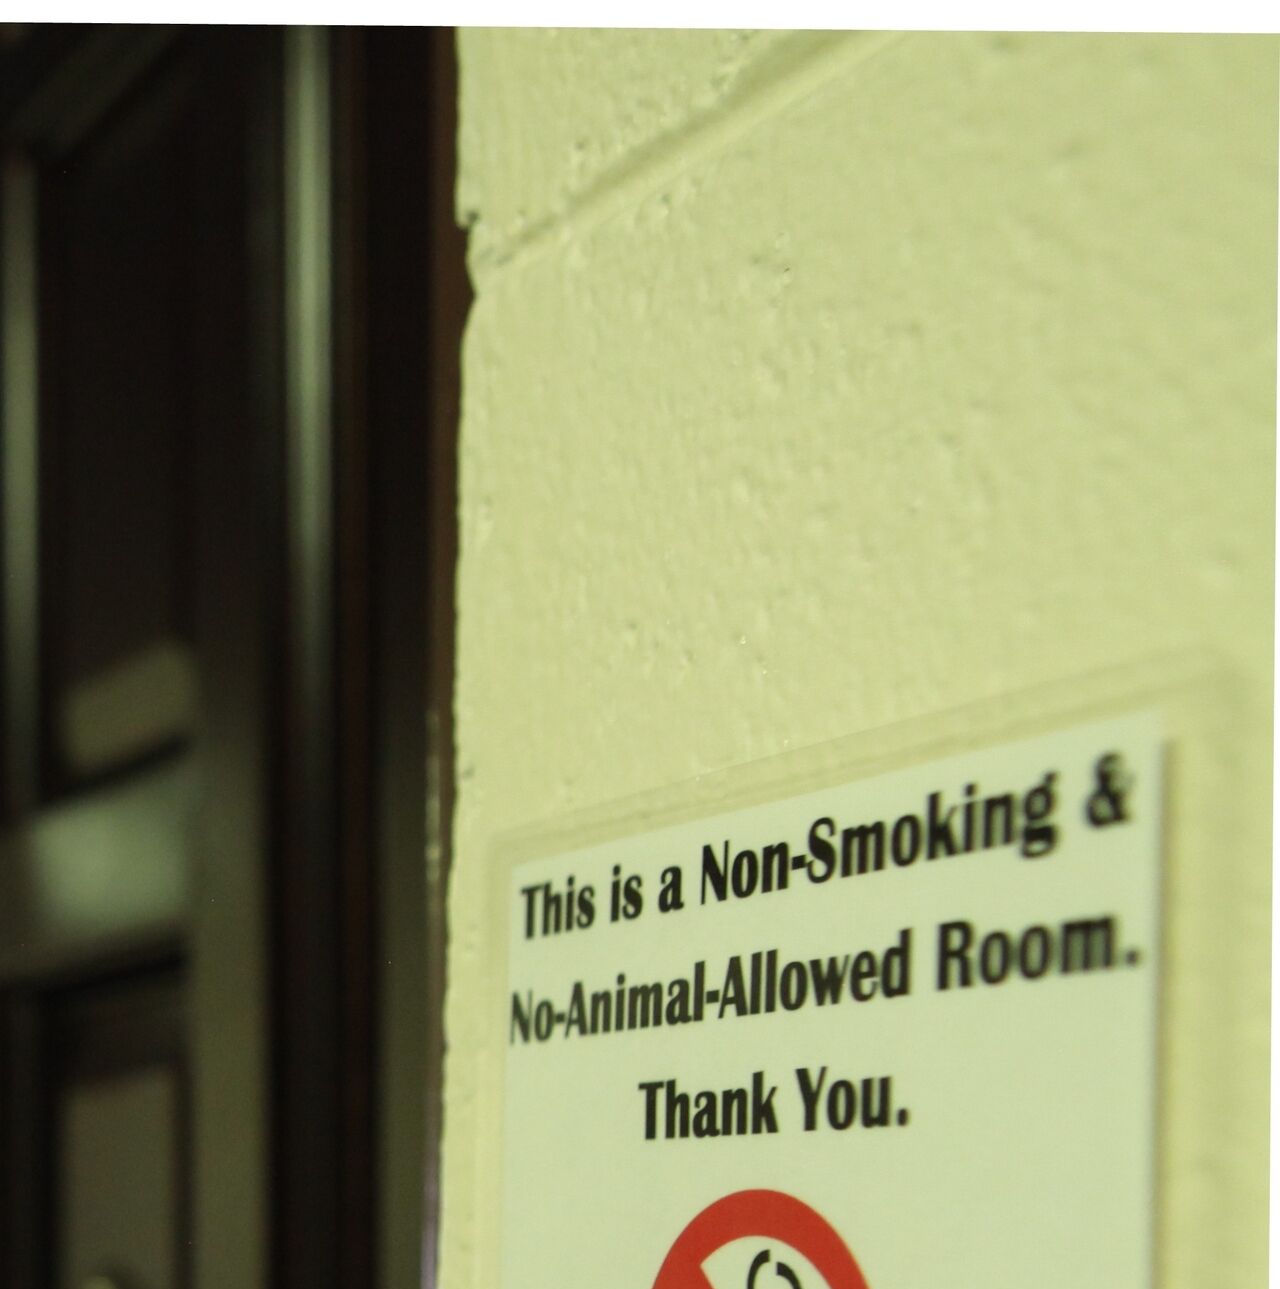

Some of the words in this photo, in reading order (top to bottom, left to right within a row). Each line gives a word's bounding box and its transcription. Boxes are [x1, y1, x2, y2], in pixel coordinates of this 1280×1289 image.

[521, 873, 596, 941] This
[609, 863, 644, 924] is
[657, 865, 685, 914] a
[700, 770, 1060, 906] Non-Smoking
[1083, 751, 1132, 830] &
[510, 926, 913, 1045] No-Animal-Allowed
[935, 913, 1142, 993] Room.
[637, 1069, 780, 1141] Thank
[794, 1064, 910, 1132] You.
